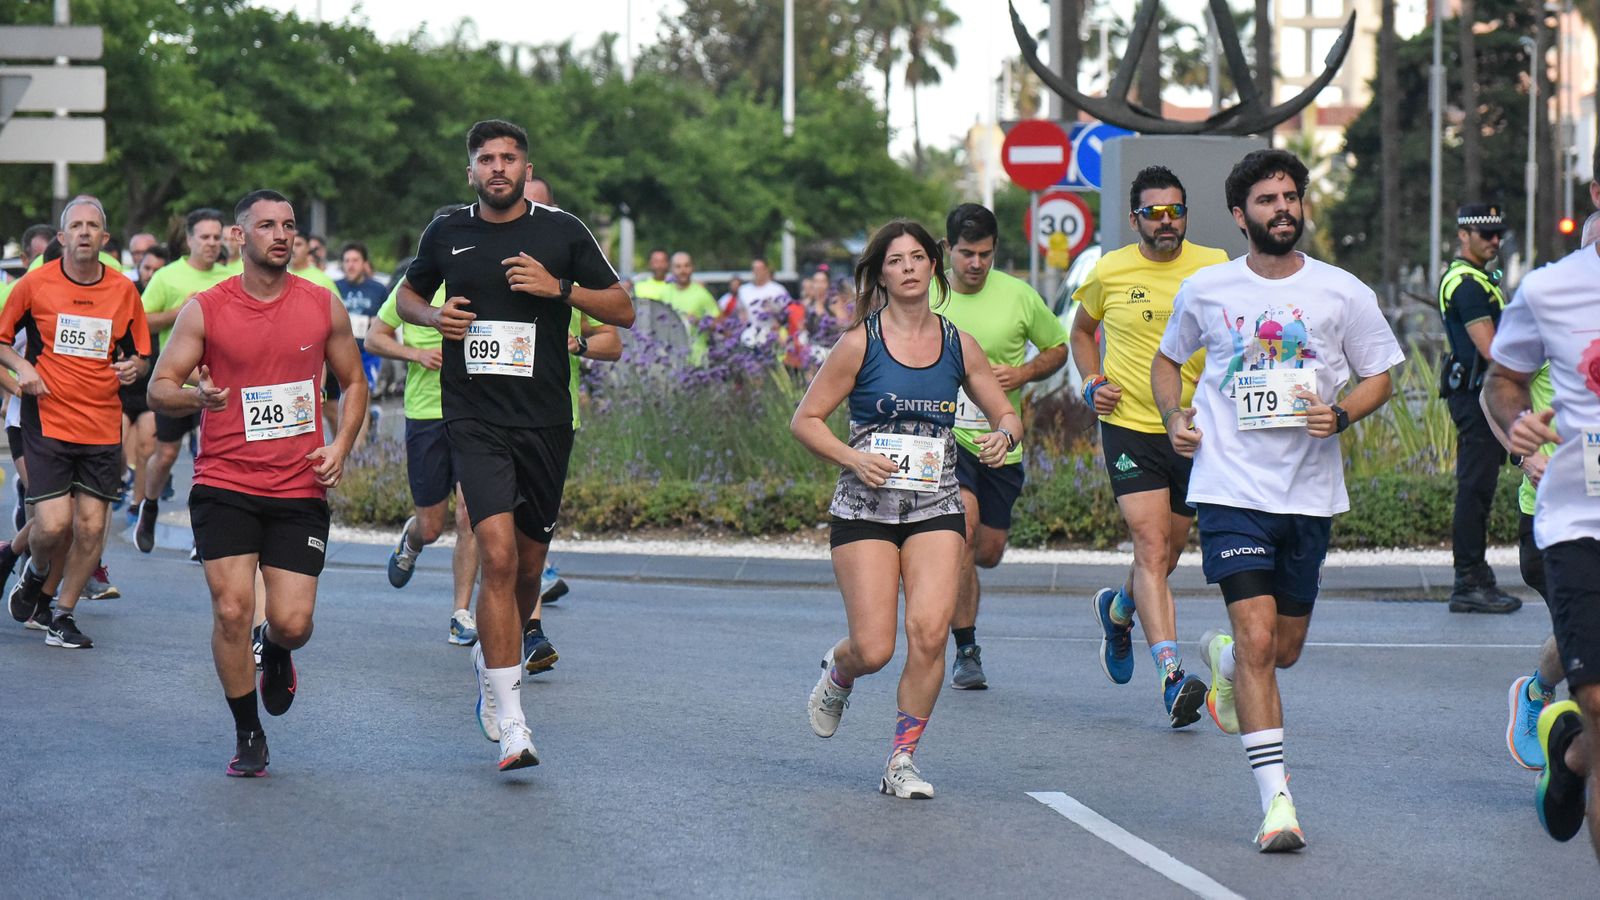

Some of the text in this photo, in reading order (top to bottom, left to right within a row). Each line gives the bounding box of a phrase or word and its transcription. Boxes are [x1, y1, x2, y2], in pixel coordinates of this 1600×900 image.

[1041, 215, 1078, 236] 30
[60, 329, 87, 346] 655
[469, 340, 501, 359] 699
[1238, 377, 1252, 386] XXI
[245, 392, 258, 401] XXI
[1243, 390, 1278, 413] 179
[250, 404, 285, 425] 248
[874, 438, 888, 447] XXI
[880, 452, 911, 474] 54
[1221, 547, 1266, 559] GIVOVA
